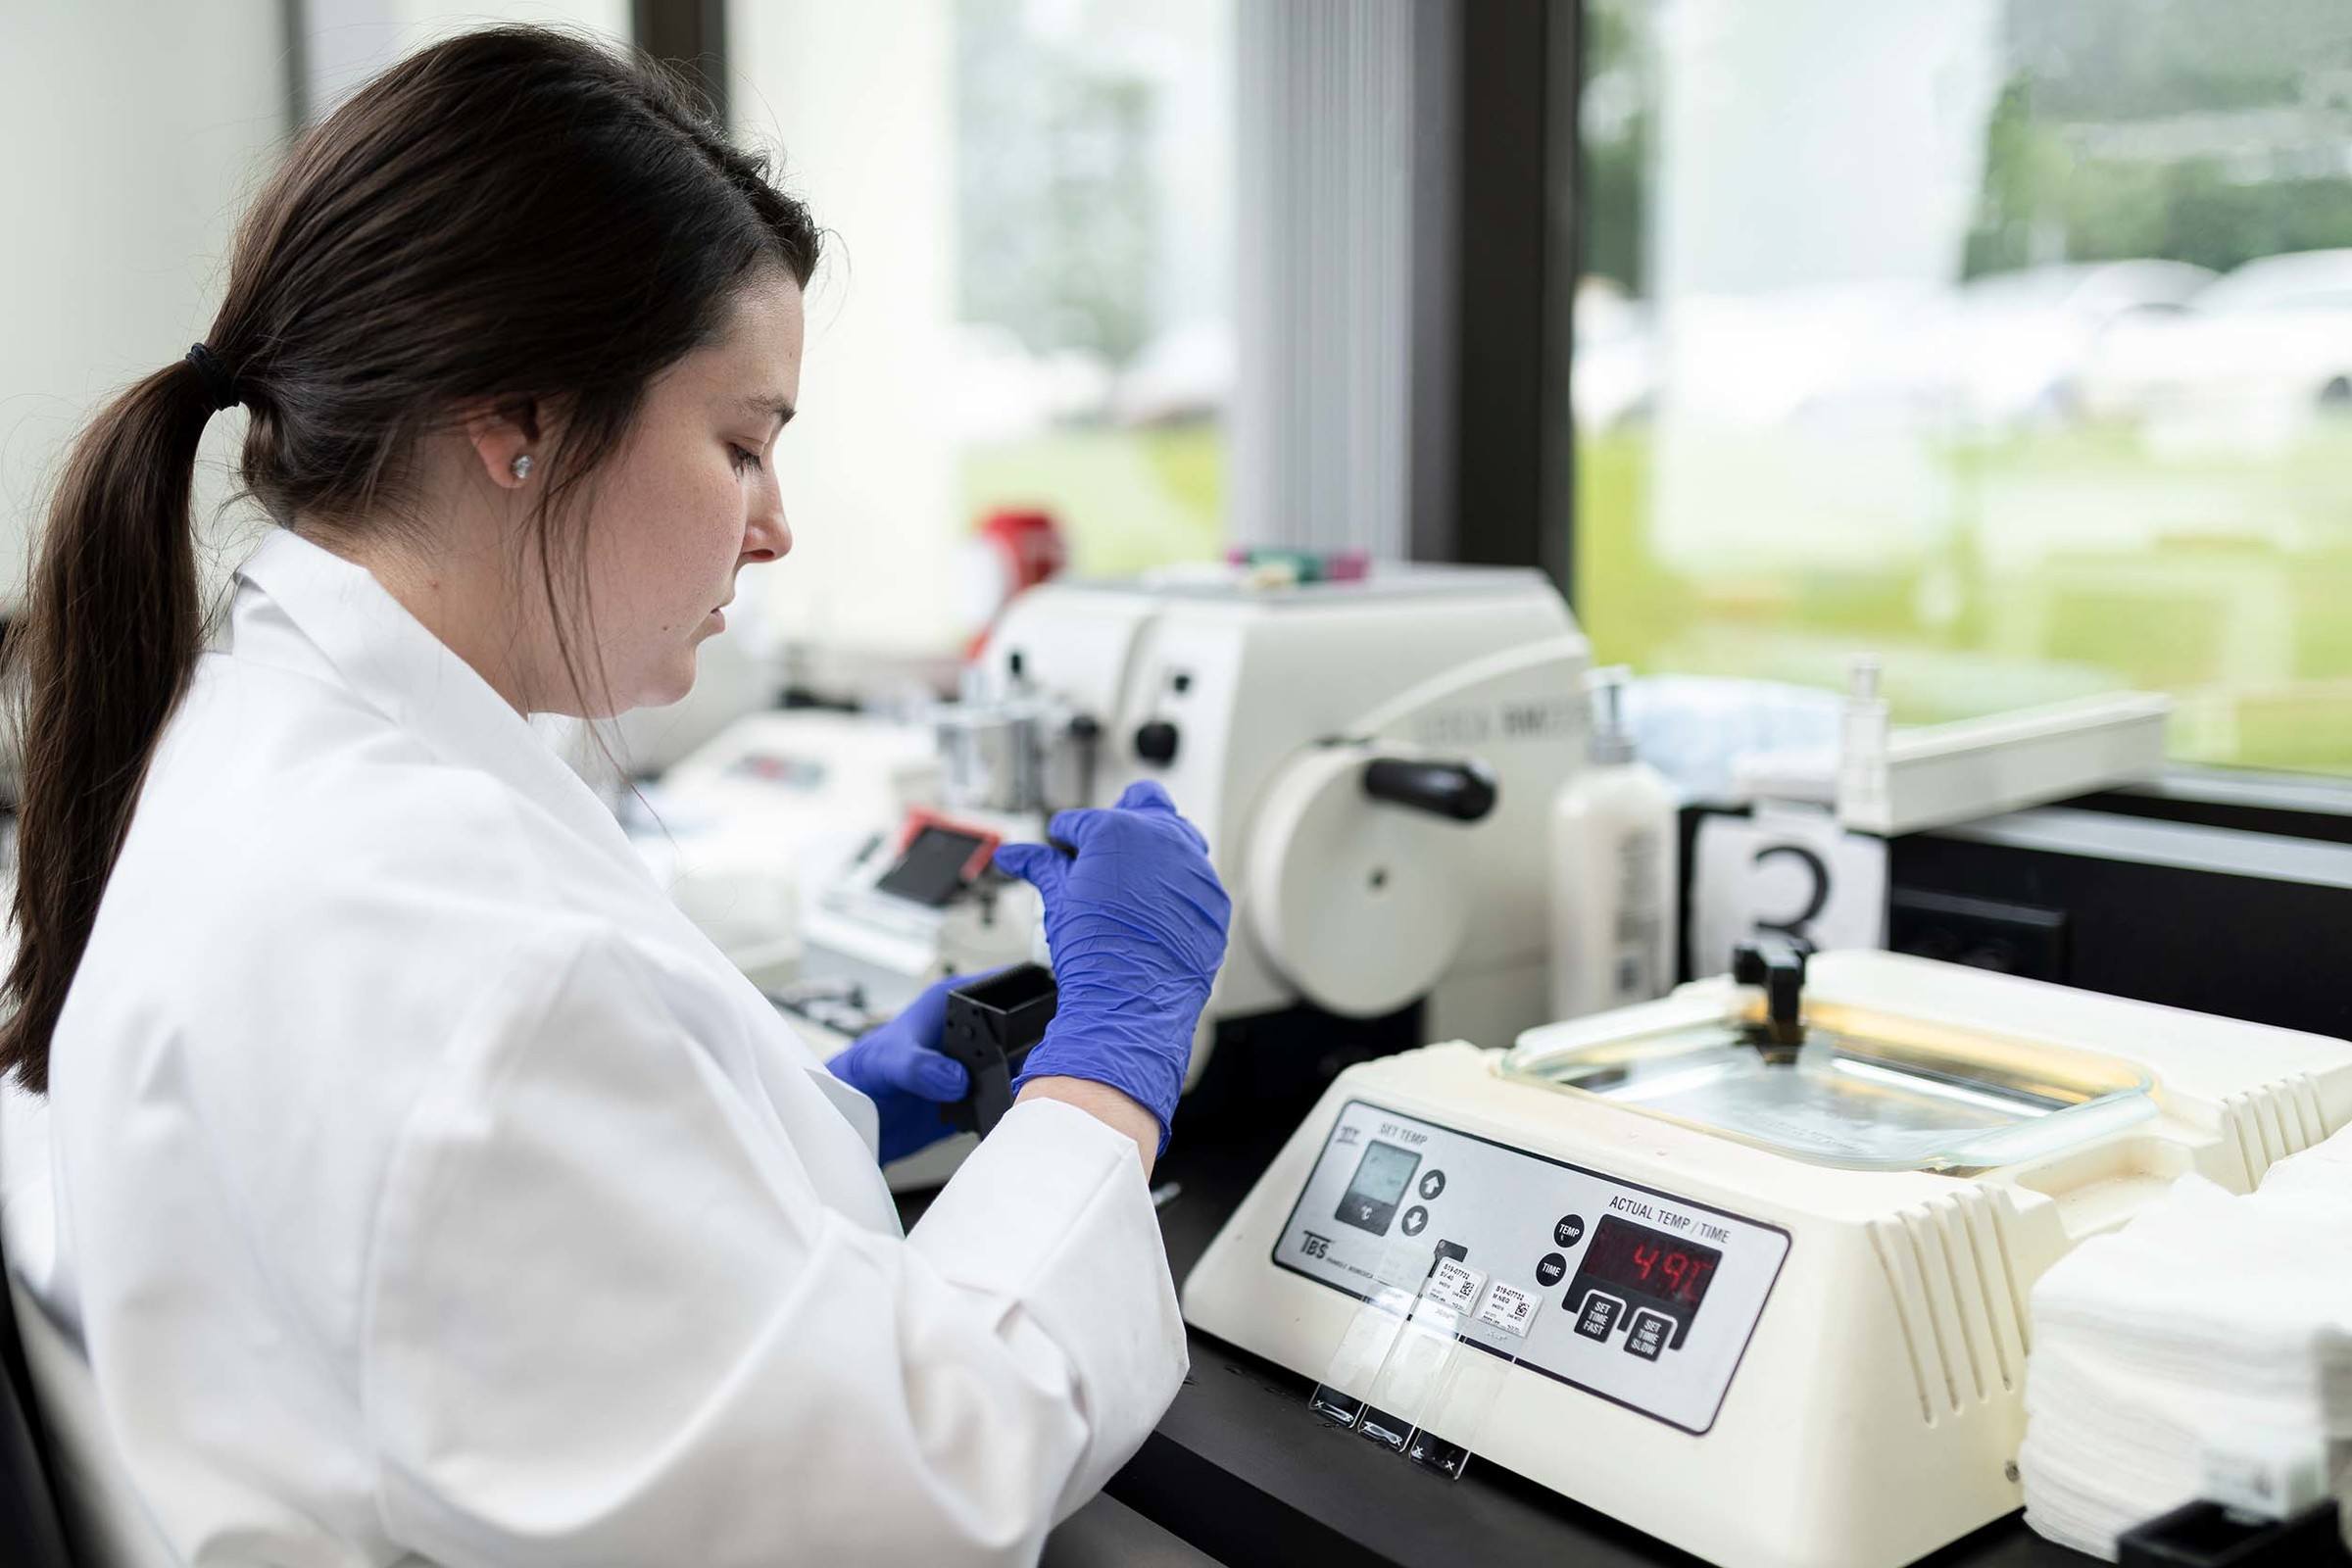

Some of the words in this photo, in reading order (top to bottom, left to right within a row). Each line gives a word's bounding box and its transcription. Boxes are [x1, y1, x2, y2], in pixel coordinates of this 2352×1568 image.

[1380, 1123, 1398, 1138] SET
[1400, 1128, 1428, 1145] TEMP
[1609, 1196, 1652, 1220] ACTUAL
[1658, 1209, 1690, 1231] TEMP
[1699, 1224, 1731, 1245] TIME
[1559, 1224, 1580, 1238] TEMP
[1300, 1230, 1332, 1259] TBS
[1543, 1262, 1561, 1277] TIME
[1594, 1301, 1611, 1314] SET
[1588, 1310, 1608, 1325] TIME
[1583, 1321, 1604, 1336] FAST
[1644, 1319, 1662, 1333] SET
[1640, 1329, 1660, 1344] TIME
[1631, 1339, 1657, 1355] SLOW
